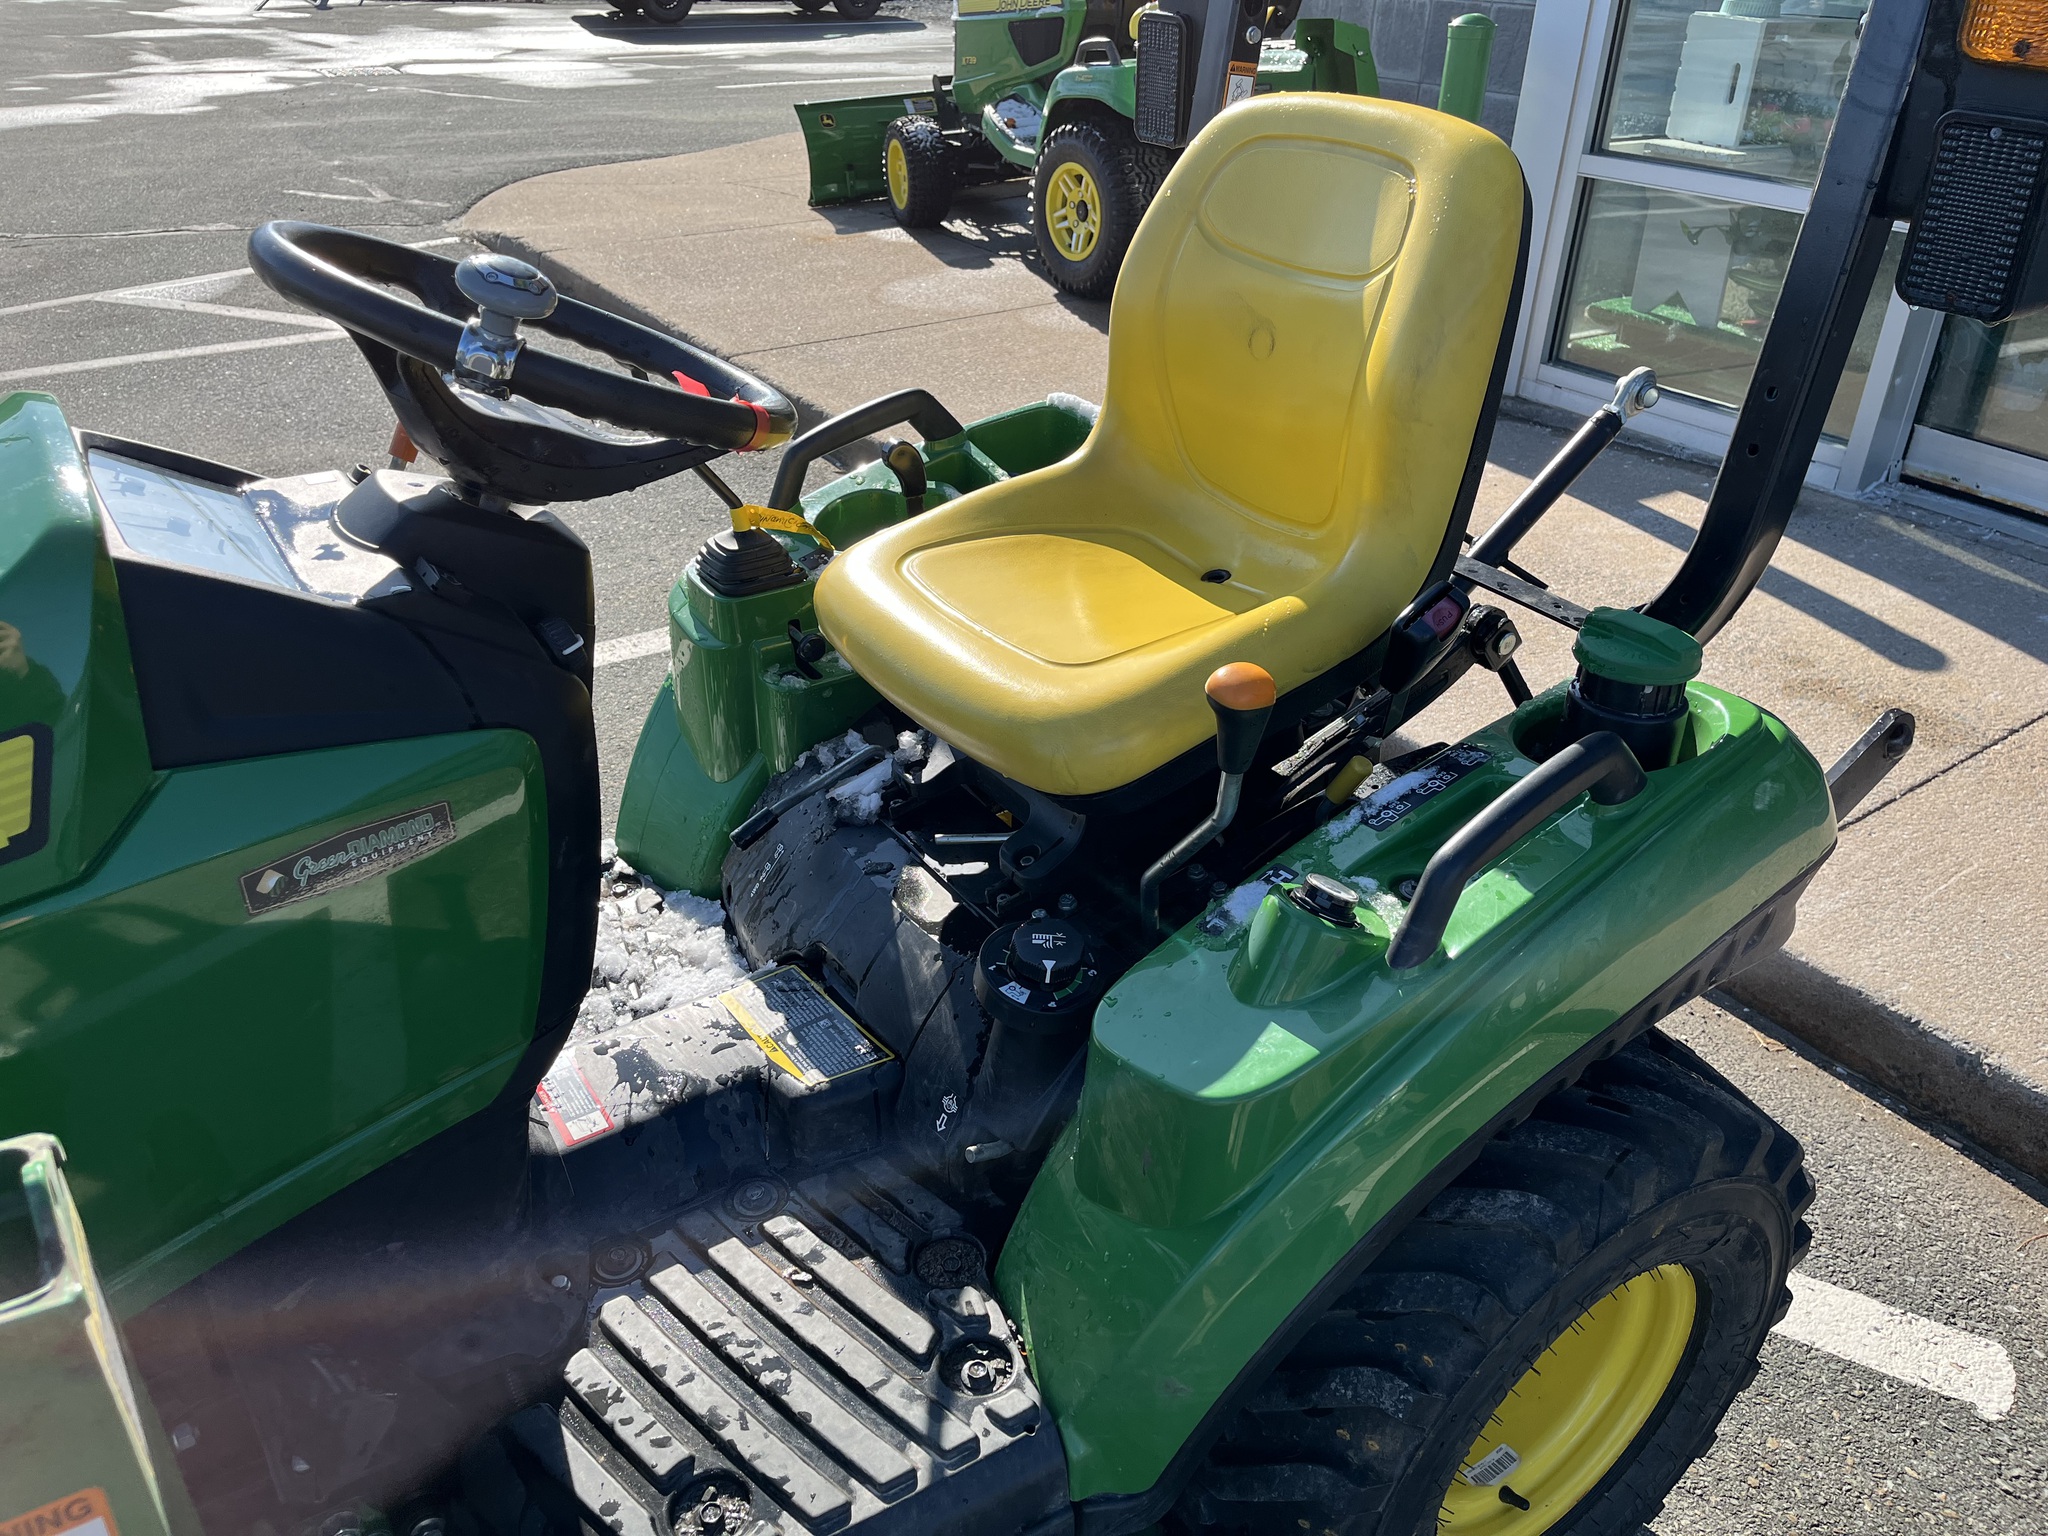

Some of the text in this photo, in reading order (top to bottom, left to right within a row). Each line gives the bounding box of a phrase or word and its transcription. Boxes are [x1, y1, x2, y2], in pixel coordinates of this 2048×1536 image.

[996, 0, 1050, 11] JOHN DEERE
[1236, 65, 1256, 75] WARNING
[1435, 610, 1453, 628] PUSH
[351, 831, 433, 867] EQUIPMENT
